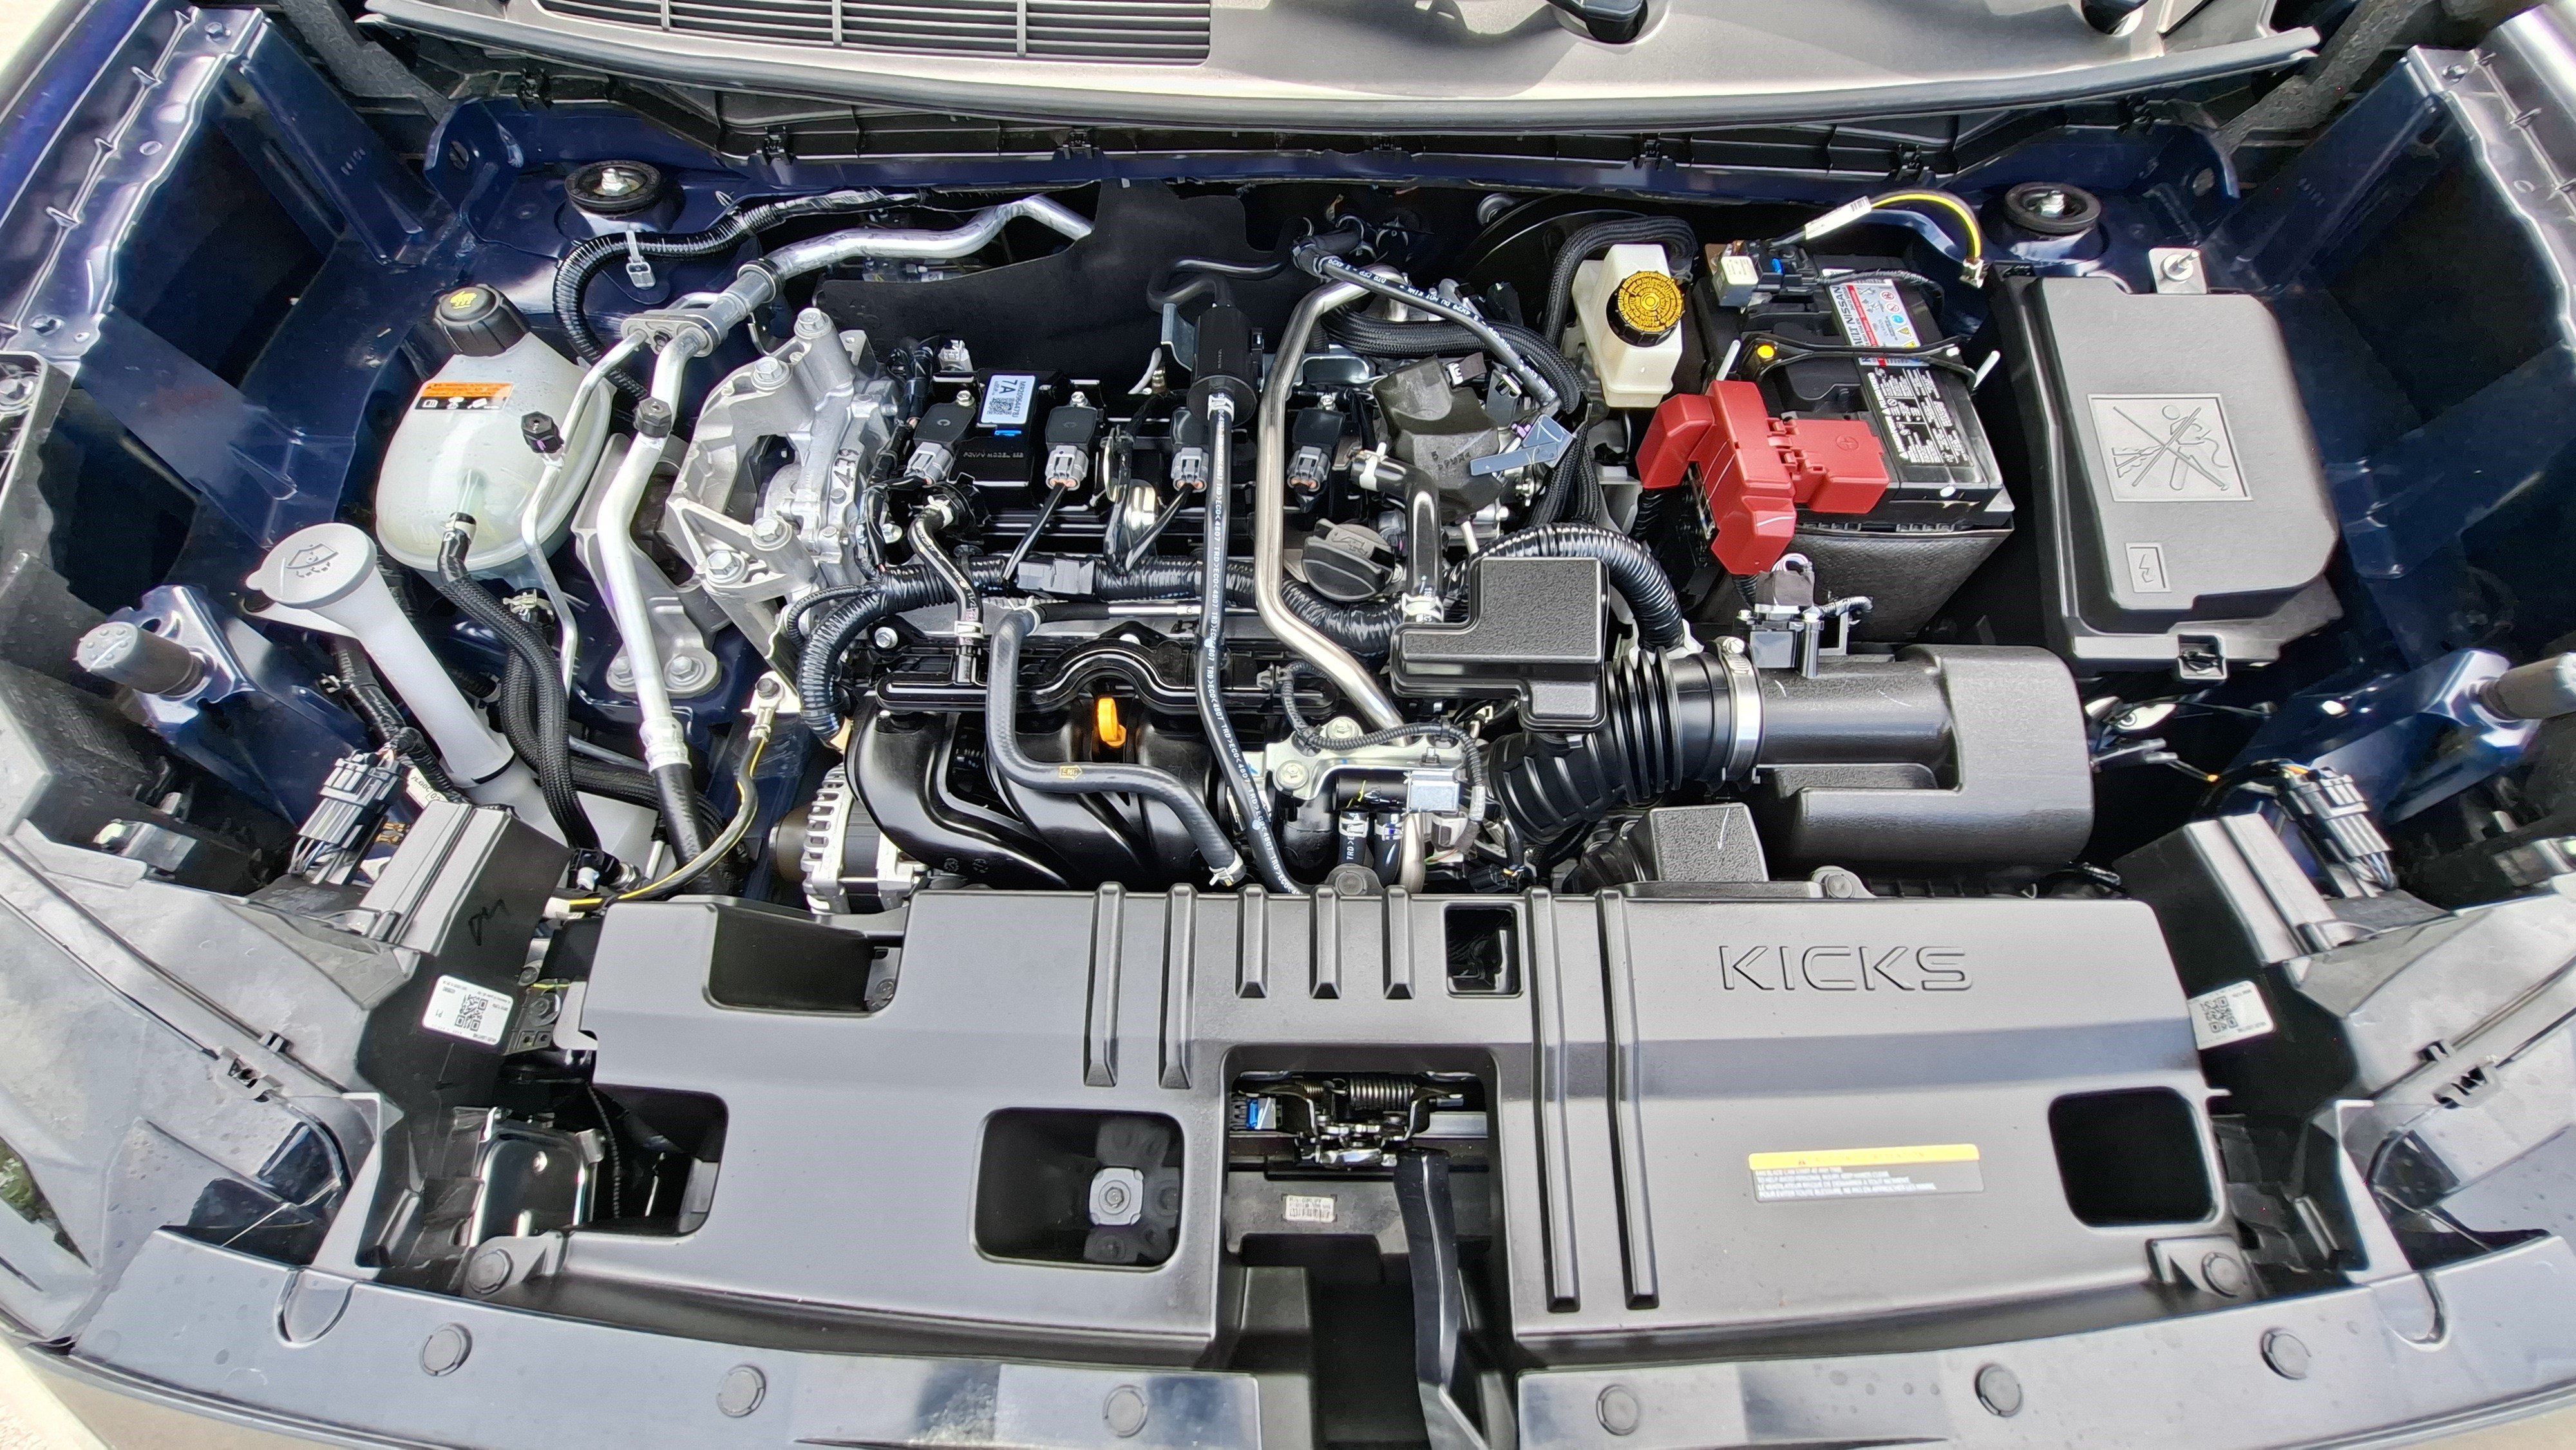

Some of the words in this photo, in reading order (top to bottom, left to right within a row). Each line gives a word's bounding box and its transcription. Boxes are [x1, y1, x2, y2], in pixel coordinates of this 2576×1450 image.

[1832, 286, 1853, 326] NISSAN
[999, 379, 1018, 394] 7A
[1213, 483, 1223, 541] TRD>ECO<4807
[1211, 546, 1221, 608] TRD>ECO<4807
[1206, 665, 1225, 721] TRD>ECO<4807
[1061, 767, 1079, 776] ENG
[1220, 724, 1251, 784] TRD>ECO<4807
[1247, 788, 1274, 851] TRD>ECO<4807
[1719, 945, 1973, 992] KICKS
